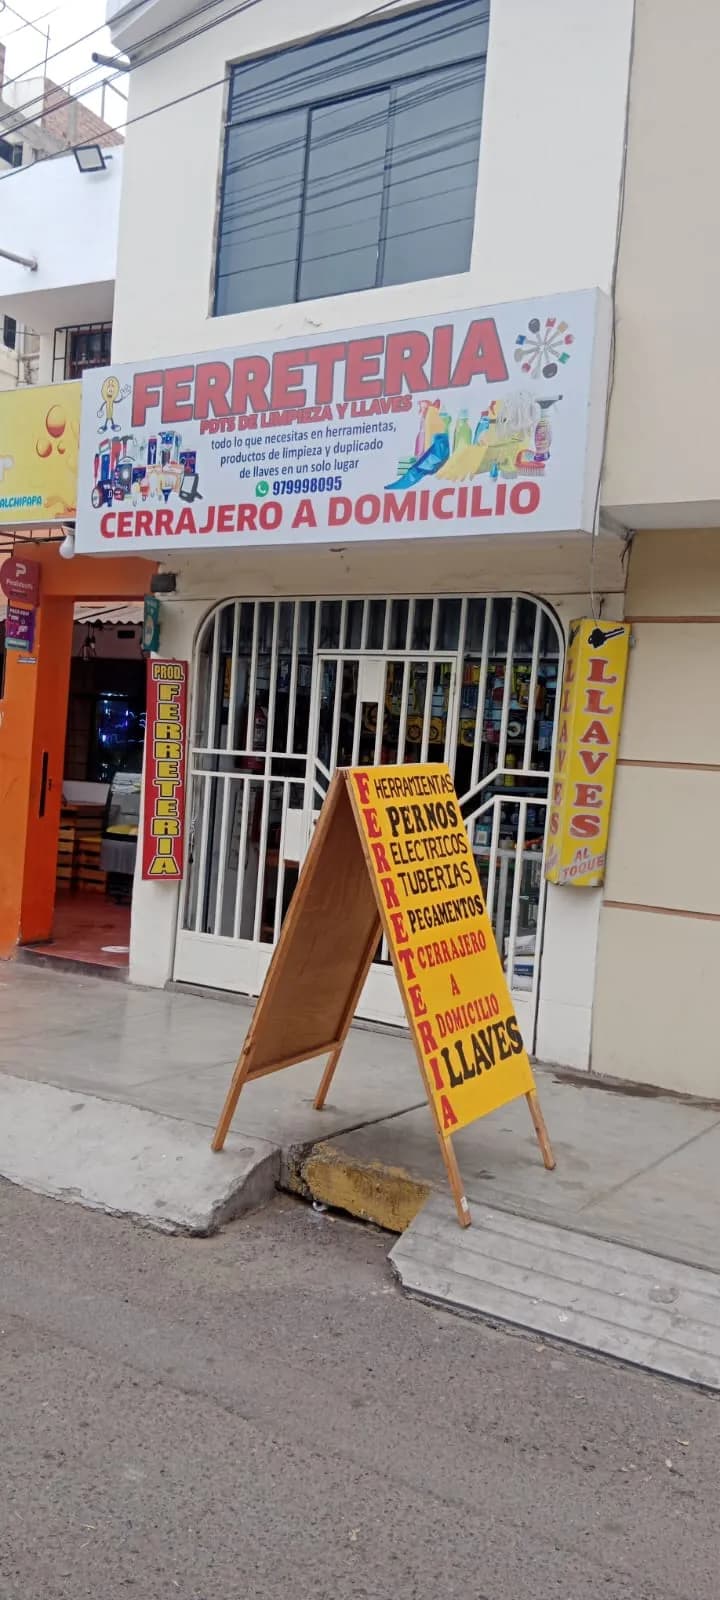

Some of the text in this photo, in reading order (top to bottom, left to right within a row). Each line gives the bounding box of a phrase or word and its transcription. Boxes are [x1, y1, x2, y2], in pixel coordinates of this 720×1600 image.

[131, 317, 509, 427] FERRETERIA
[238, 413, 258, 430] DE
[261, 404, 333, 428] LIMPIEZA
[336, 402, 349, 419] Y
[351, 394, 412, 418] LLAVES
[211, 421, 397, 450] todo lo que necesitas en herramientas,
[220, 439, 383, 467] productos de limpieza y duplicado
[239, 459, 360, 479] de llaves en un solo lugar
[272, 475, 343, 496] 979998095
[100, 481, 541, 539] CERRAJERO A DOMICILIO
[153, 663, 184, 681] PROD.
[569, 658, 617, 838] LLAVES
[150, 683, 182, 875] FERRETERIA
[374, 773, 454, 800] HERRAMIENTAS
[385, 801, 458, 837] PERNOS
[390, 833, 468, 865] ELECTRICOS
[576, 847, 592, 861] AL
[397, 861, 473, 897] TUBERIAS
[406, 894, 484, 934] PEGAMENTOS
[353, 772, 458, 1129] FERRETERIA
[417, 929, 487, 970] CERRAJERO
[450, 973, 461, 997] A
[435, 993, 500, 1038] DOMICILIO
[441, 1014, 524, 1088] LLAVES
